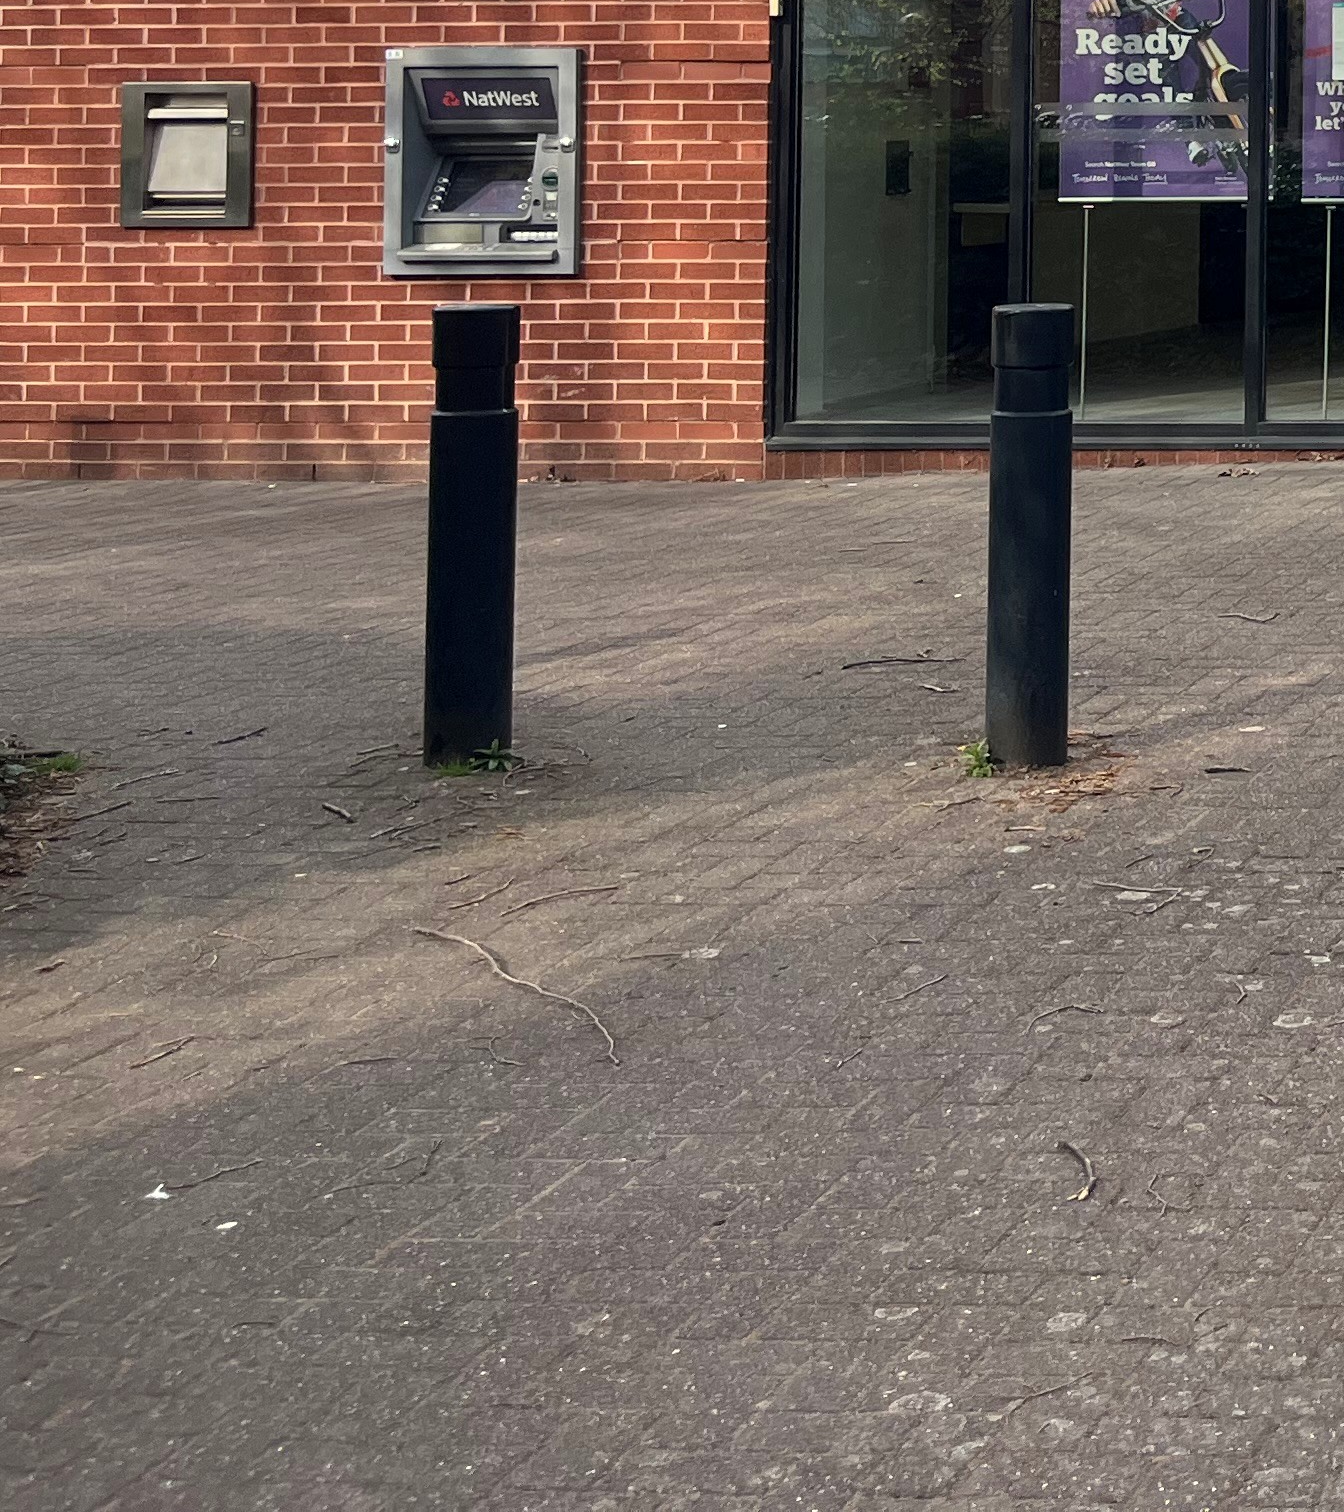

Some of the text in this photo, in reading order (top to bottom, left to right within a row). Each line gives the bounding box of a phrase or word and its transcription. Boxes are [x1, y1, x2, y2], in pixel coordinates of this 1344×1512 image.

[1075, 27, 1192, 61] Ready
[1104, 58, 1163, 85] set
[462, 90, 540, 107] NatWest
